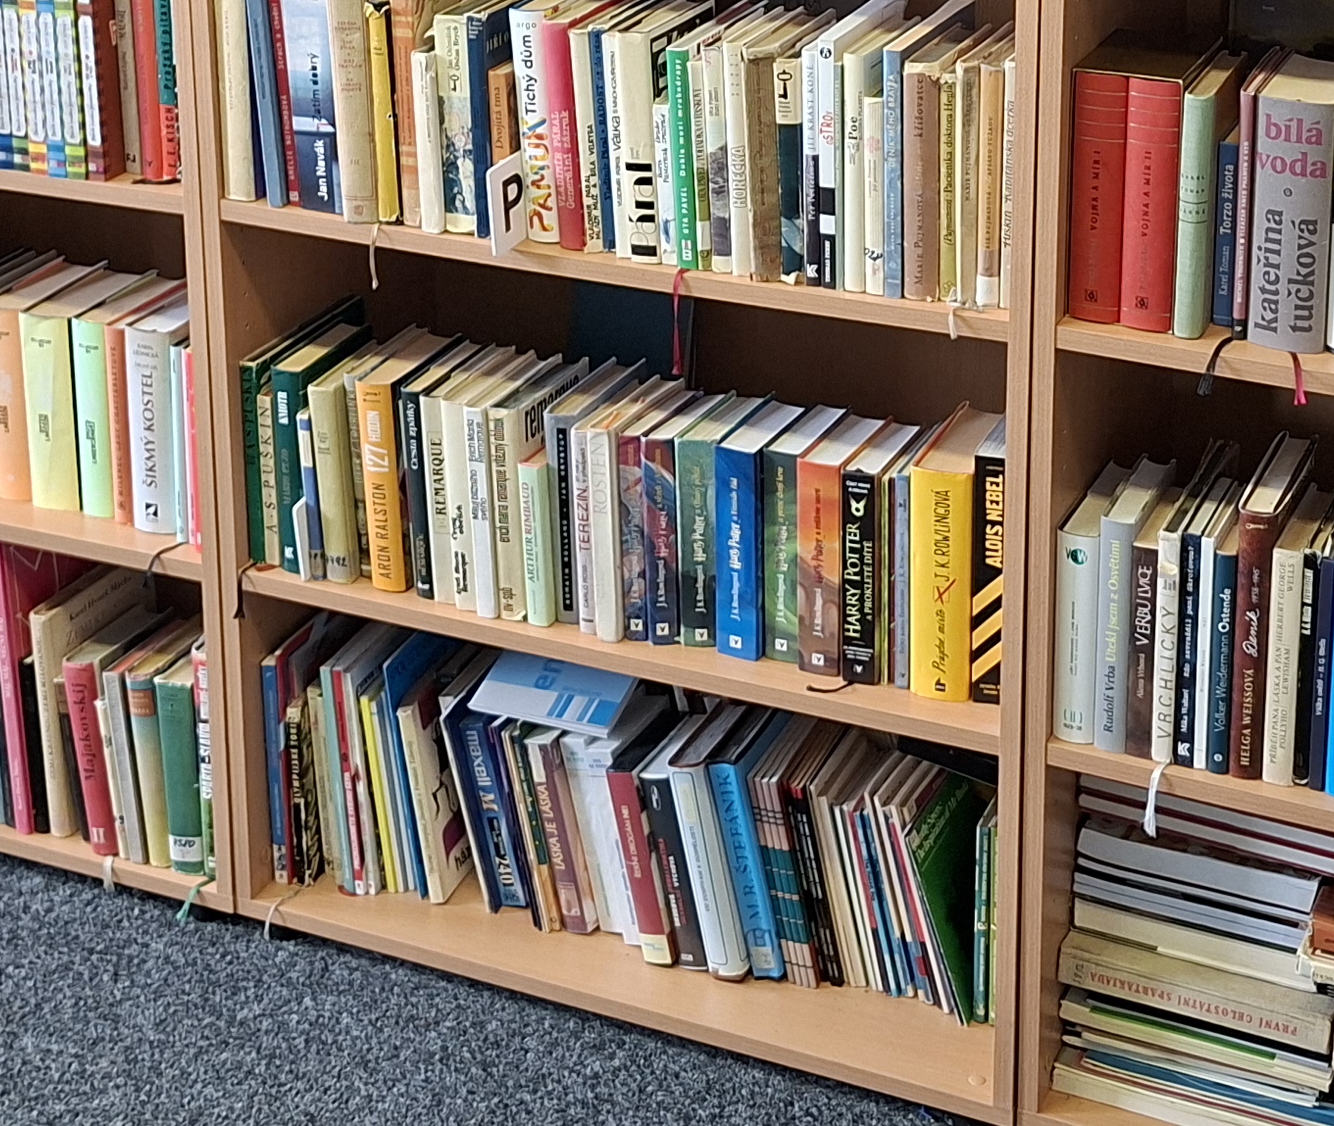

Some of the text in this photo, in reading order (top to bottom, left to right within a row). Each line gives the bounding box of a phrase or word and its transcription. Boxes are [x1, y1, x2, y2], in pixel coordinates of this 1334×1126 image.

[523, 35, 537, 116] Tichý dům
[849, 116, 859, 140] Poe
[1264, 113, 1324, 147] bílá
[1257, 151, 1328, 180] voda
[503, 173, 523, 232] P
[1253, 208, 1285, 336] kateřina
[1287, 218, 1320, 335] tučková
[139, 371, 155, 432] KOSTEL
[430, 438, 445, 517] REMARQUE
[984, 475, 1005, 569] ALOIS NEBEL
[845, 524, 862, 580] POTTER
[843, 587, 861, 640] HARRY
[1218, 588, 1231, 631] Ostende
[1240, 731, 1251, 766] HELGA
